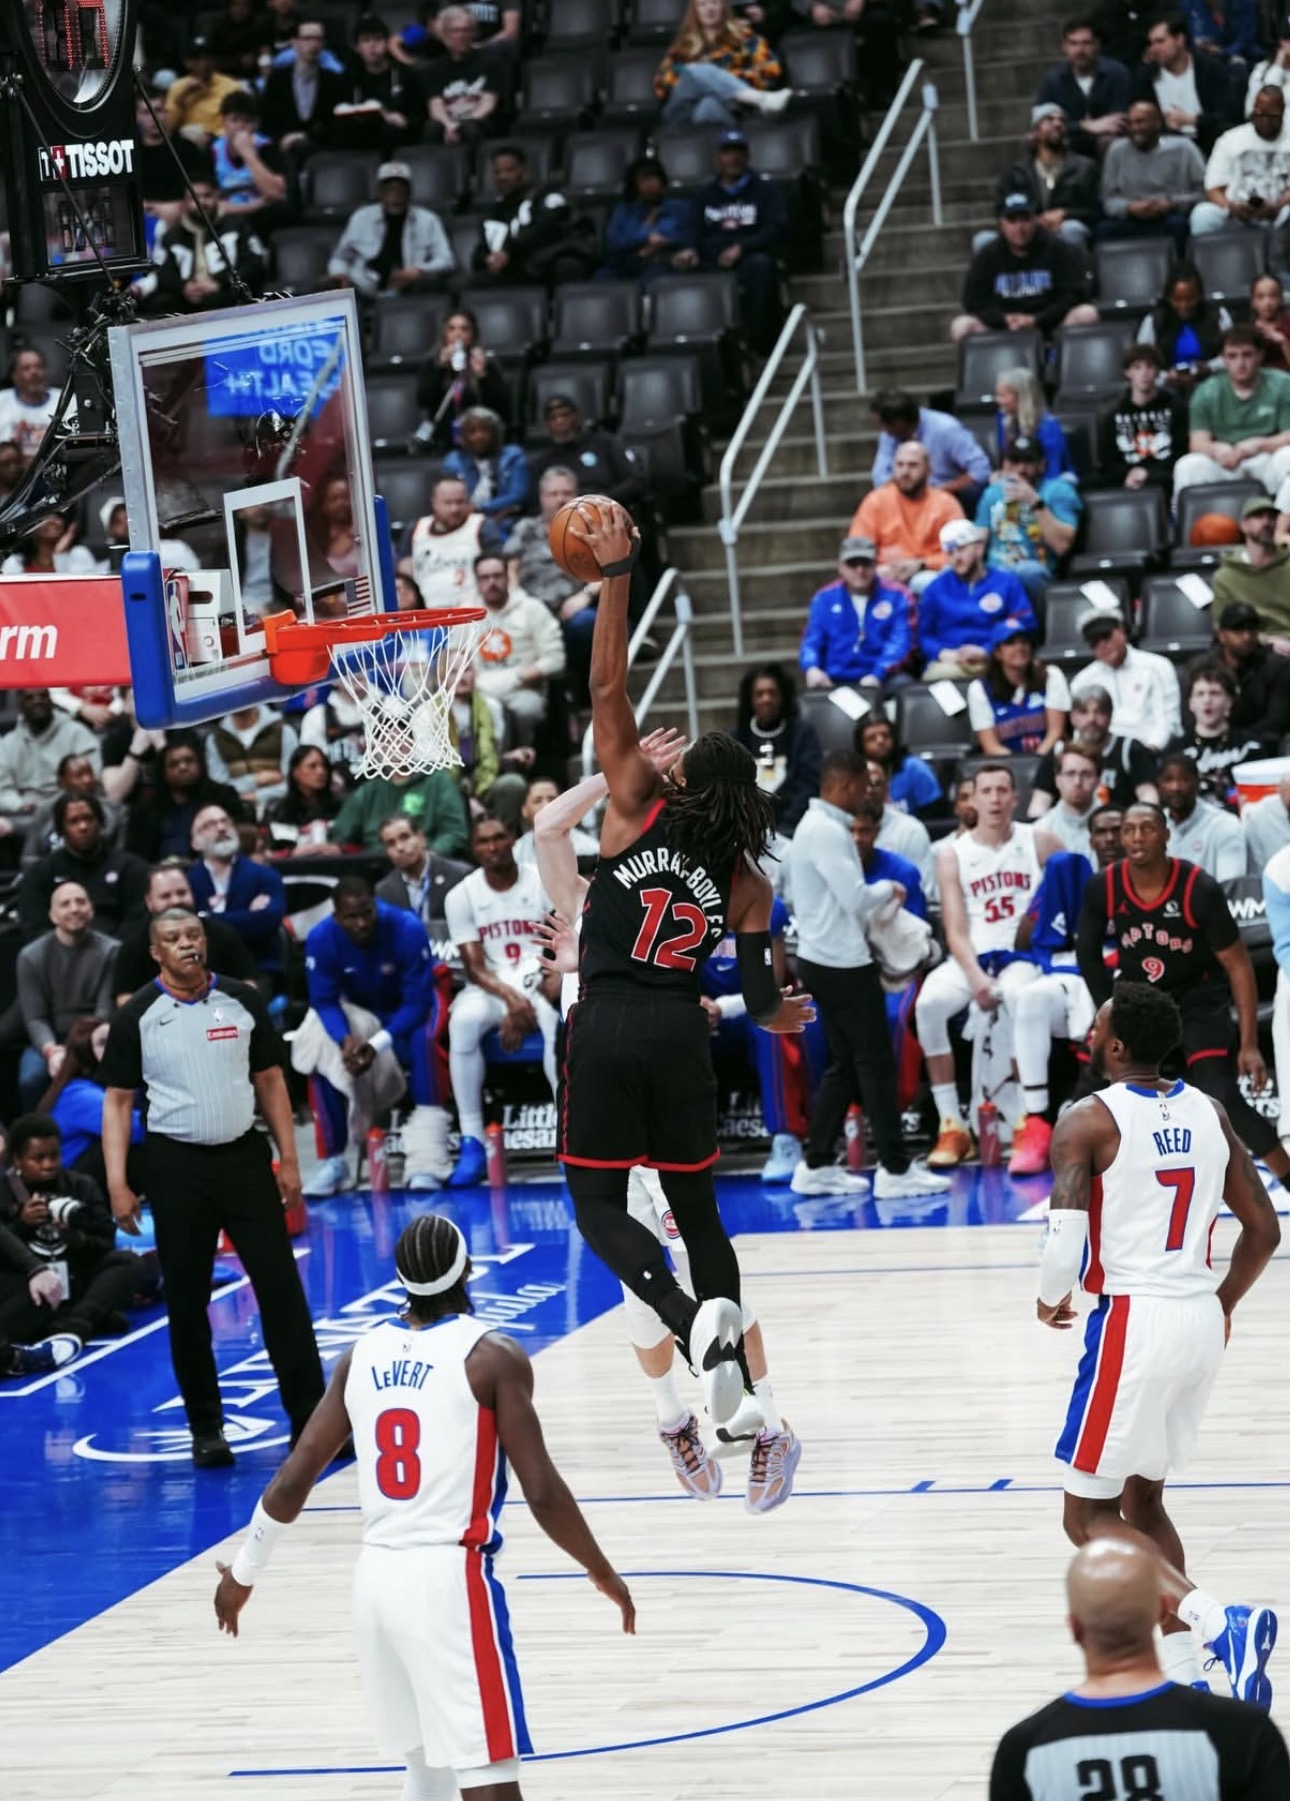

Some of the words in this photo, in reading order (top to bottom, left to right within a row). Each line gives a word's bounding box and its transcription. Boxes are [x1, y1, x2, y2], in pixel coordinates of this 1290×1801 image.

[65, 139, 135, 179] TISSOT
[970, 871, 1031, 898] PISTONS
[984, 895, 1015, 923] 55
[477, 919, 542, 940] PISTON
[631, 887, 709, 972] 12
[1121, 922, 1193, 954] APTORS
[504, 942, 521, 967] 9
[1141, 956, 1165, 983] 9
[502, 1103, 558, 1129] Littl
[1152, 1127, 1192, 1156] REED
[1154, 1166, 1195, 1251] 7
[375, 1407, 422, 1501] 8
[1076, 1754, 1165, 1801] 28
